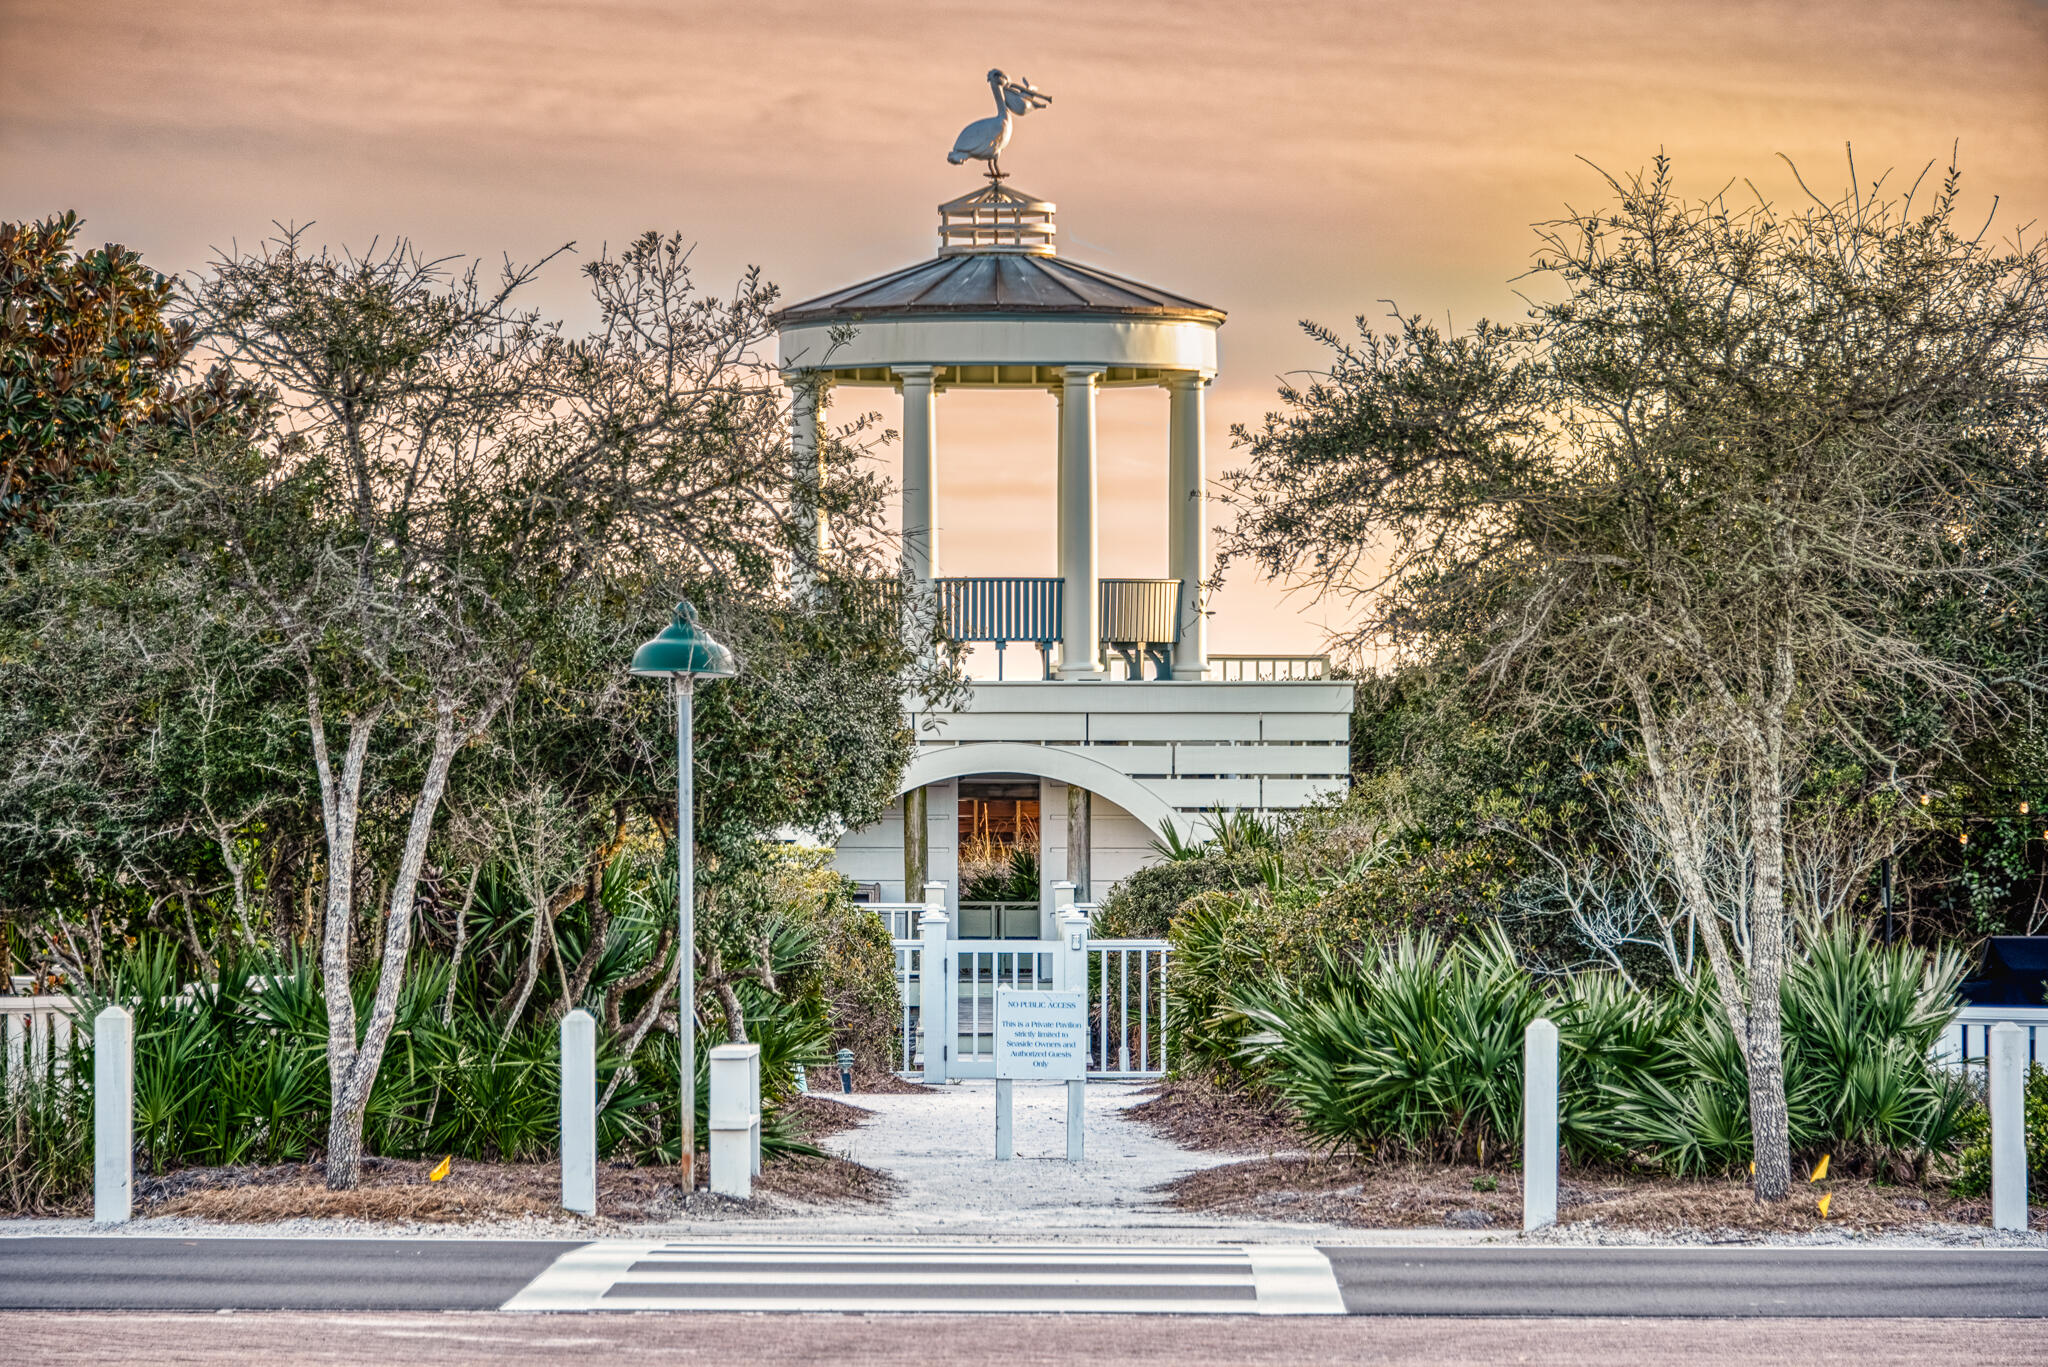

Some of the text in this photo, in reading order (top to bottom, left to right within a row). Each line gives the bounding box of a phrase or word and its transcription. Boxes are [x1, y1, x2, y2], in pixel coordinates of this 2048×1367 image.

[1008, 1001, 1076, 1009] NO PUBLIC ACCESS
[1002, 1020, 1016, 1028] This
[1056, 1021, 1082, 1029] Pavilion
[1014, 1031, 1035, 1039] strictly
[1006, 1040, 1033, 1048] Seaside
[1048, 1050, 1072, 1058] Guests
[1032, 1060, 1048, 1068] Only
